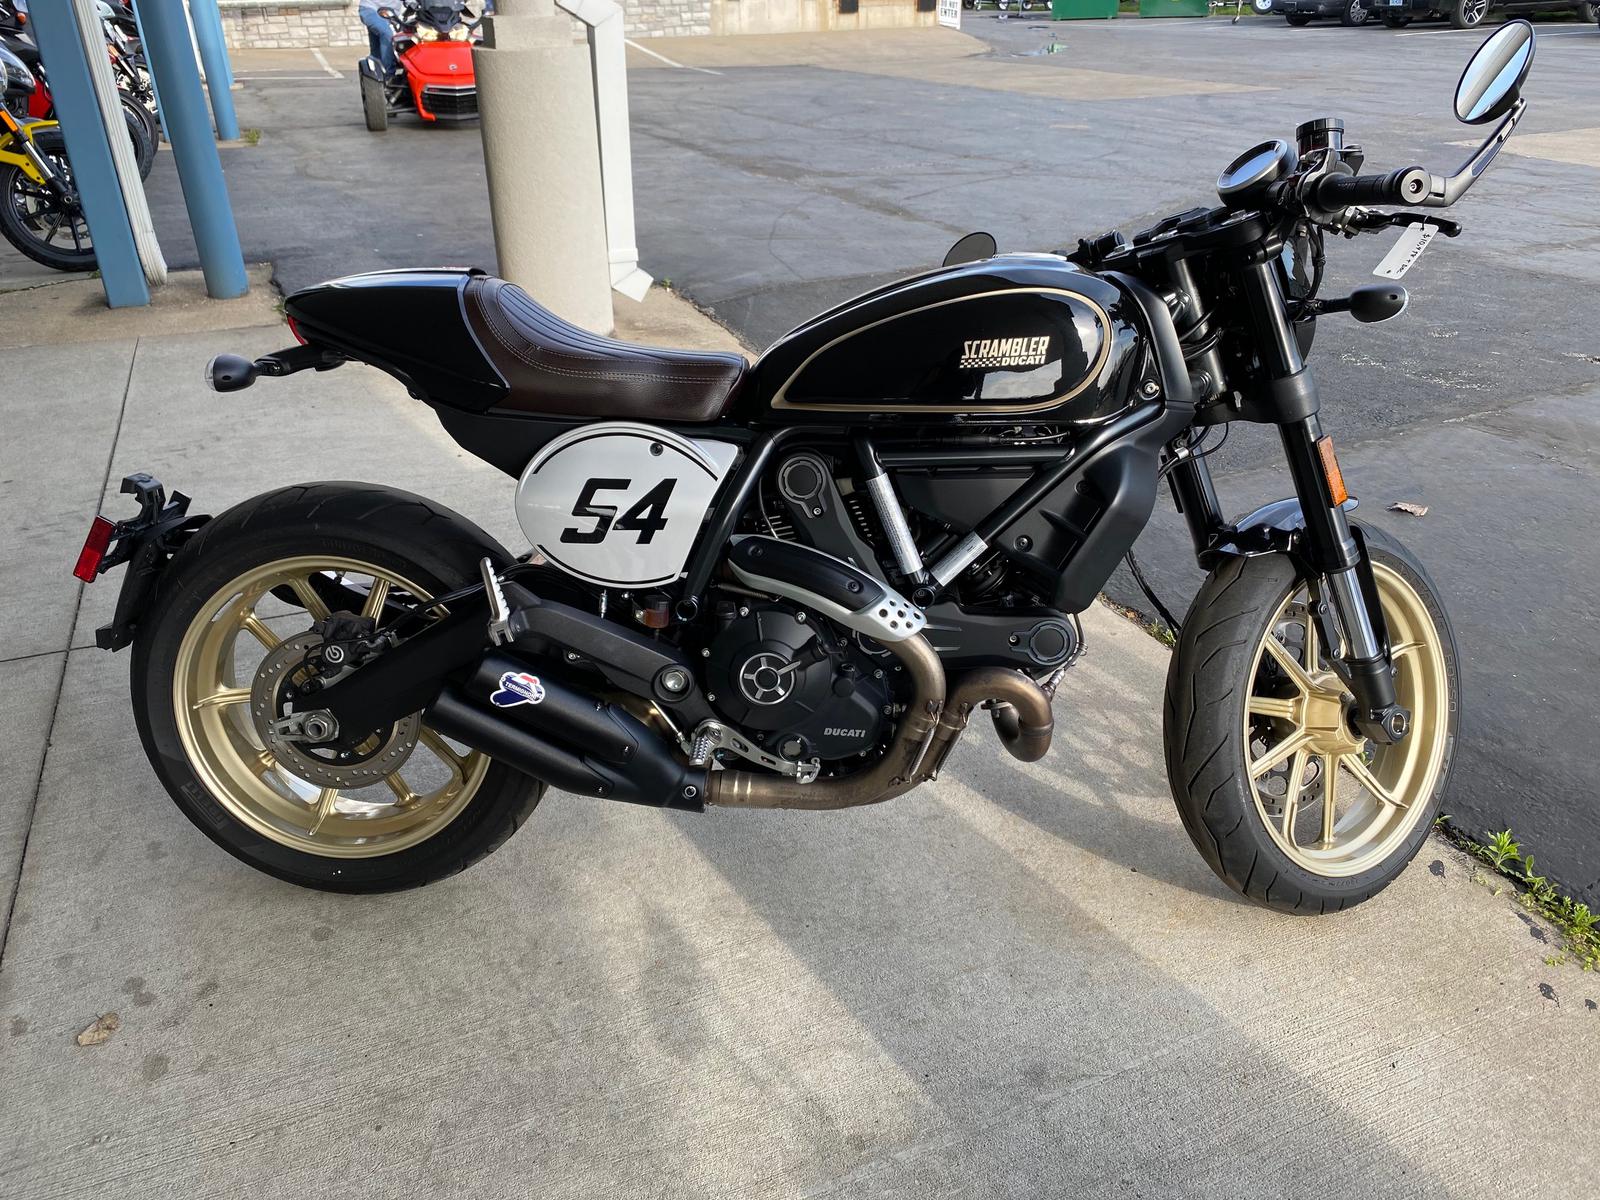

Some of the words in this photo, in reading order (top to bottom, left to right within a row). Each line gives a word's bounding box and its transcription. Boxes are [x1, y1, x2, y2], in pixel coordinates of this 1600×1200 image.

[940, 8, 958, 18] ENTER
[961, 336, 1050, 359] SCRAMBLER
[1001, 355, 1046, 366] DUCATI
[559, 477, 678, 545] 54
[823, 727, 866, 738] DUCATI
